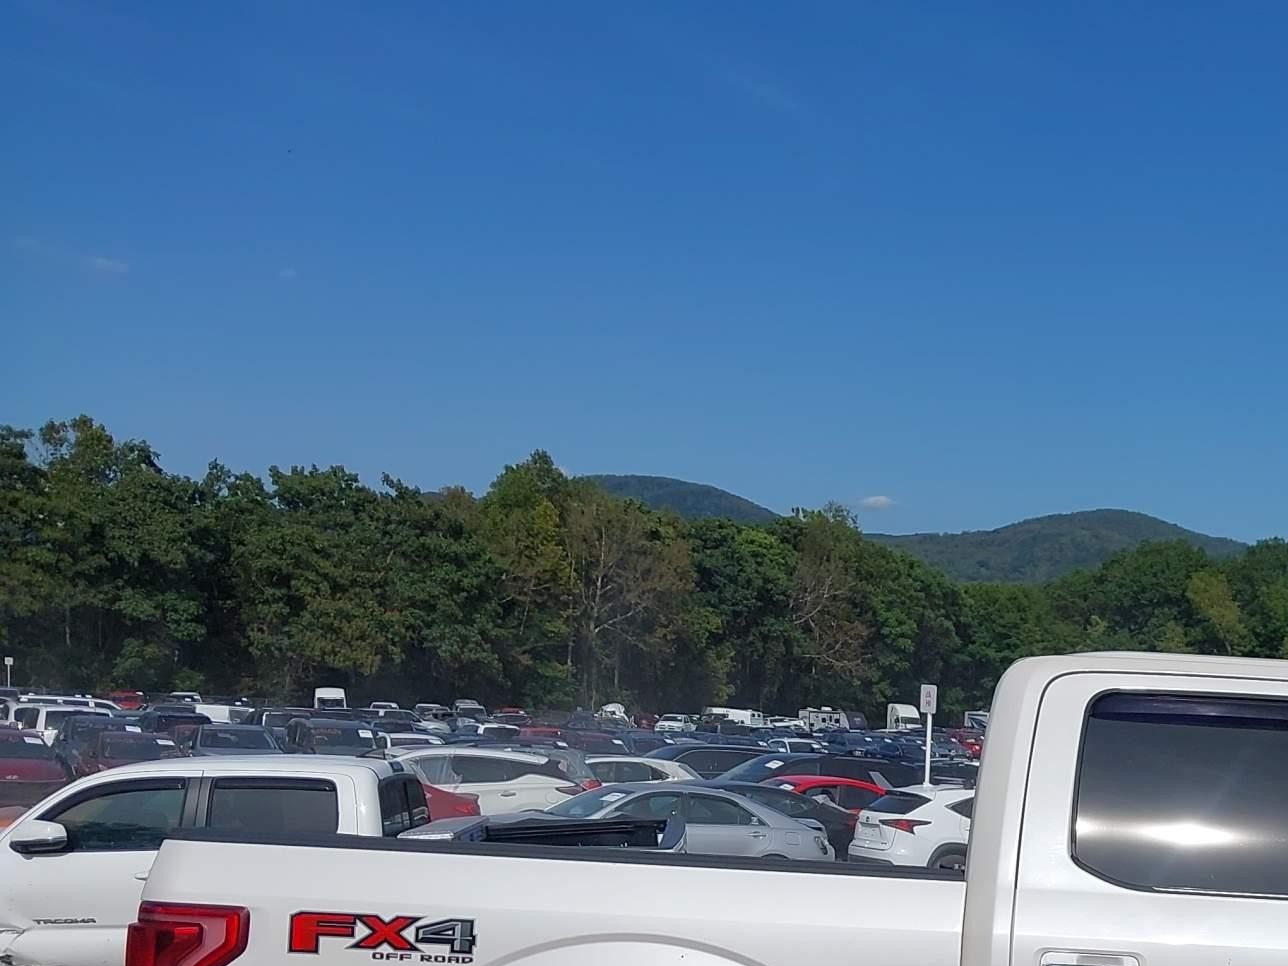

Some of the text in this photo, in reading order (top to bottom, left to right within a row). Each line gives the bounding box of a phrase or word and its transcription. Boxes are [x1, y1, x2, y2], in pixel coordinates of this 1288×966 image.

[288, 911, 477, 955] FX4
[372, 952, 474, 964] OFF ROAD
